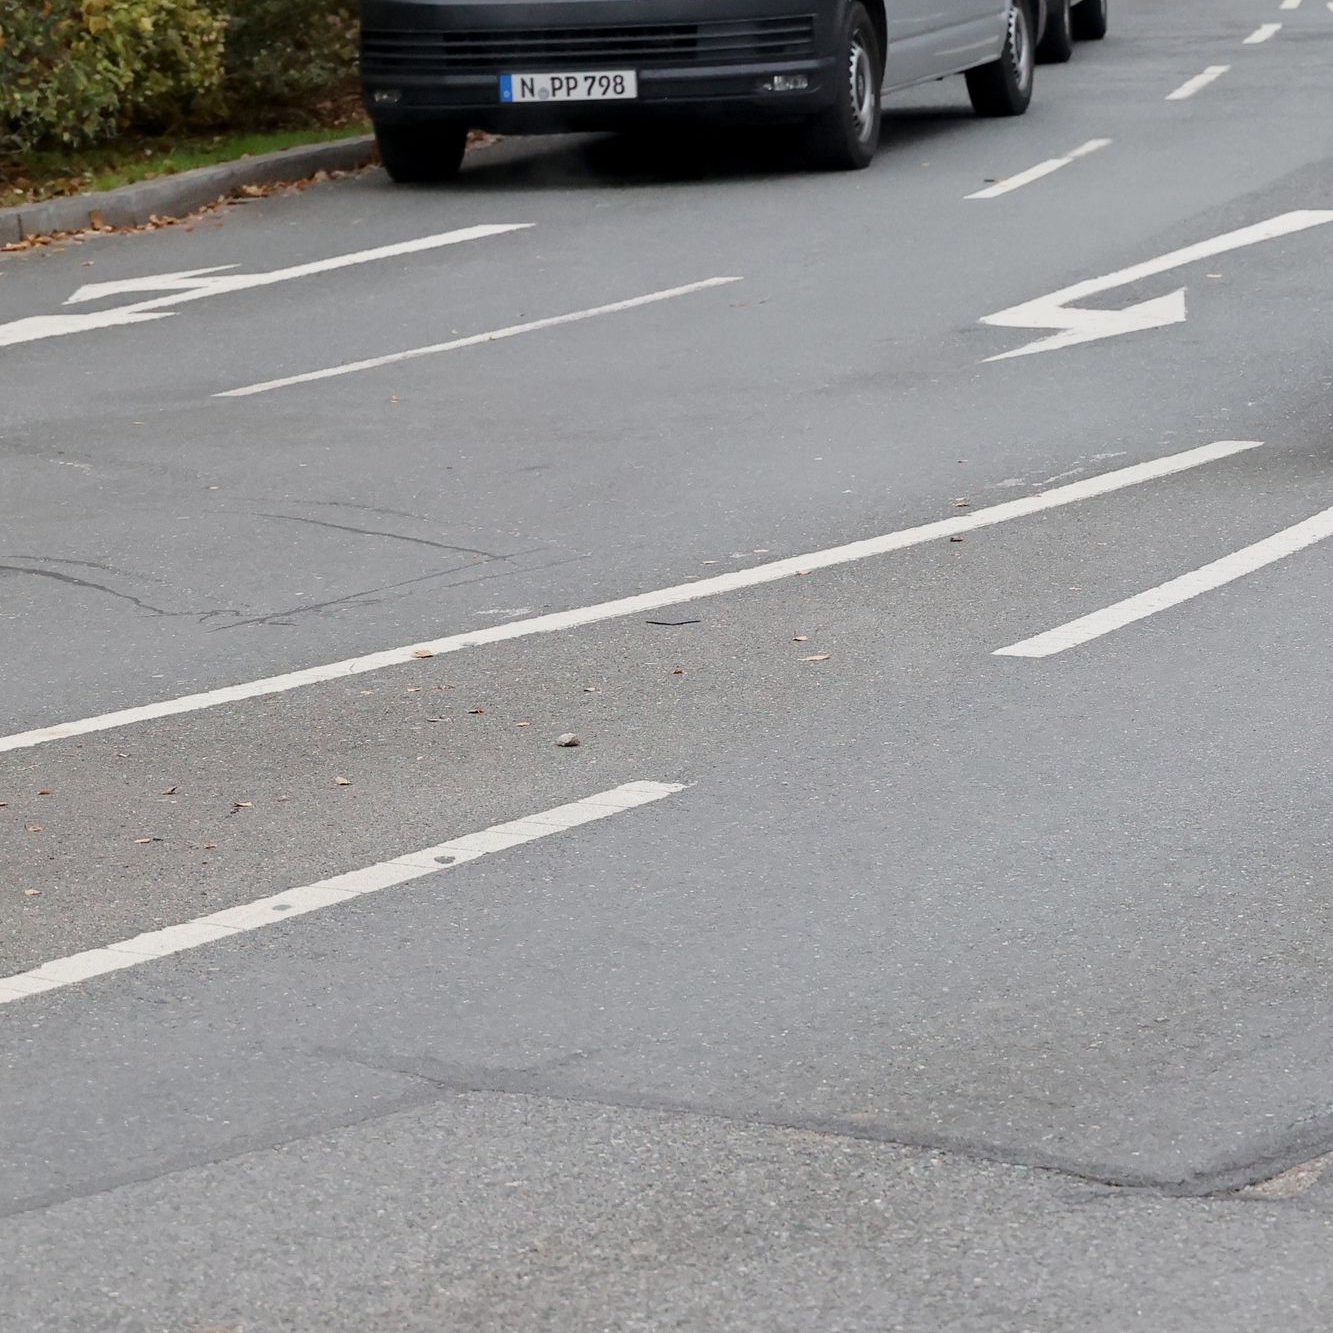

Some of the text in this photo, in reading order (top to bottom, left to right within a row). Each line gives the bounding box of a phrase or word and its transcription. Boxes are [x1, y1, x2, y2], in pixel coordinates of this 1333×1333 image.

[520, 74, 625, 98] N PP 798
